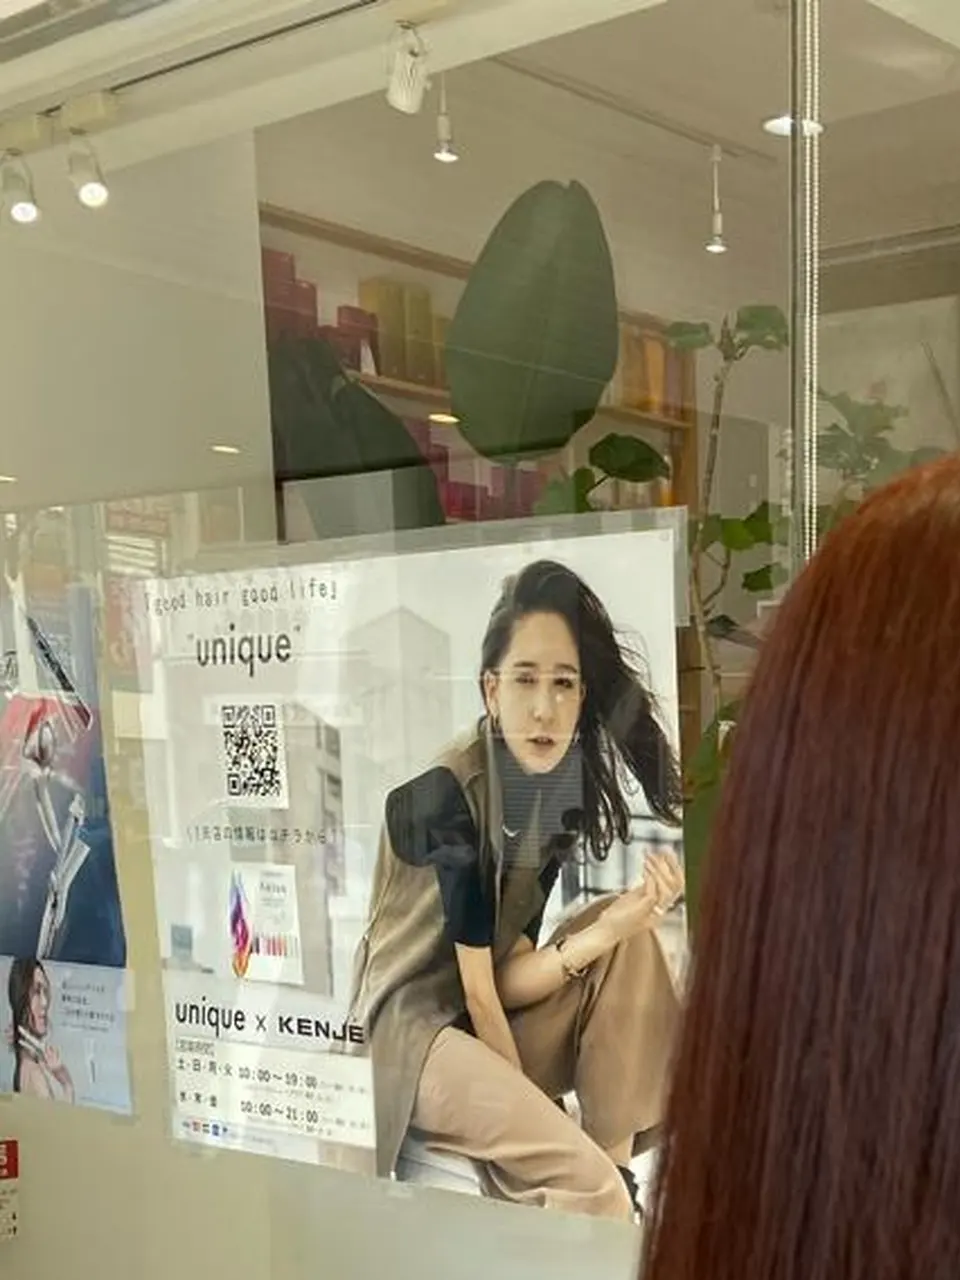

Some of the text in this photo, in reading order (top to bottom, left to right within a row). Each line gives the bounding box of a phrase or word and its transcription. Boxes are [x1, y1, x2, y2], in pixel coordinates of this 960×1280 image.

[196, 589, 229, 608] hair
[242, 585, 278, 607] good
[175, 995, 246, 1038] unique
[278, 1014, 365, 1045] KENJE
